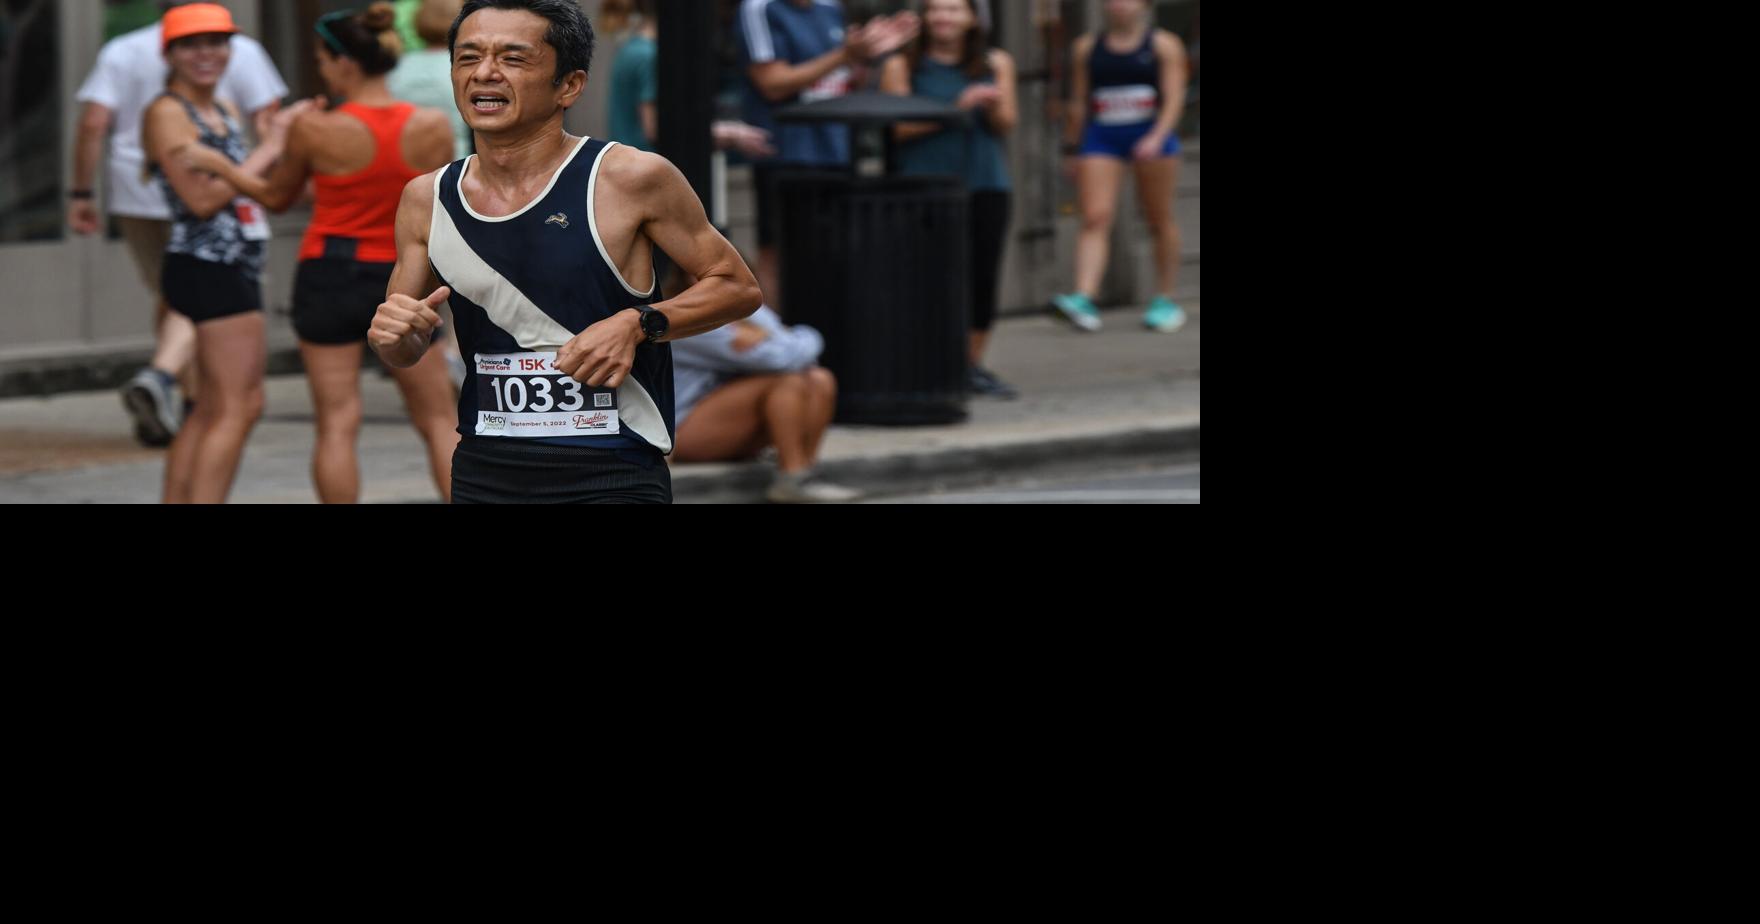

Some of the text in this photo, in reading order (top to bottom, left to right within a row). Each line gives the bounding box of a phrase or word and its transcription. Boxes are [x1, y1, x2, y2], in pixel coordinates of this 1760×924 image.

[518, 359, 545, 370] 15K
[491, 377, 584, 412] 1033
[483, 414, 506, 427] Mercy
